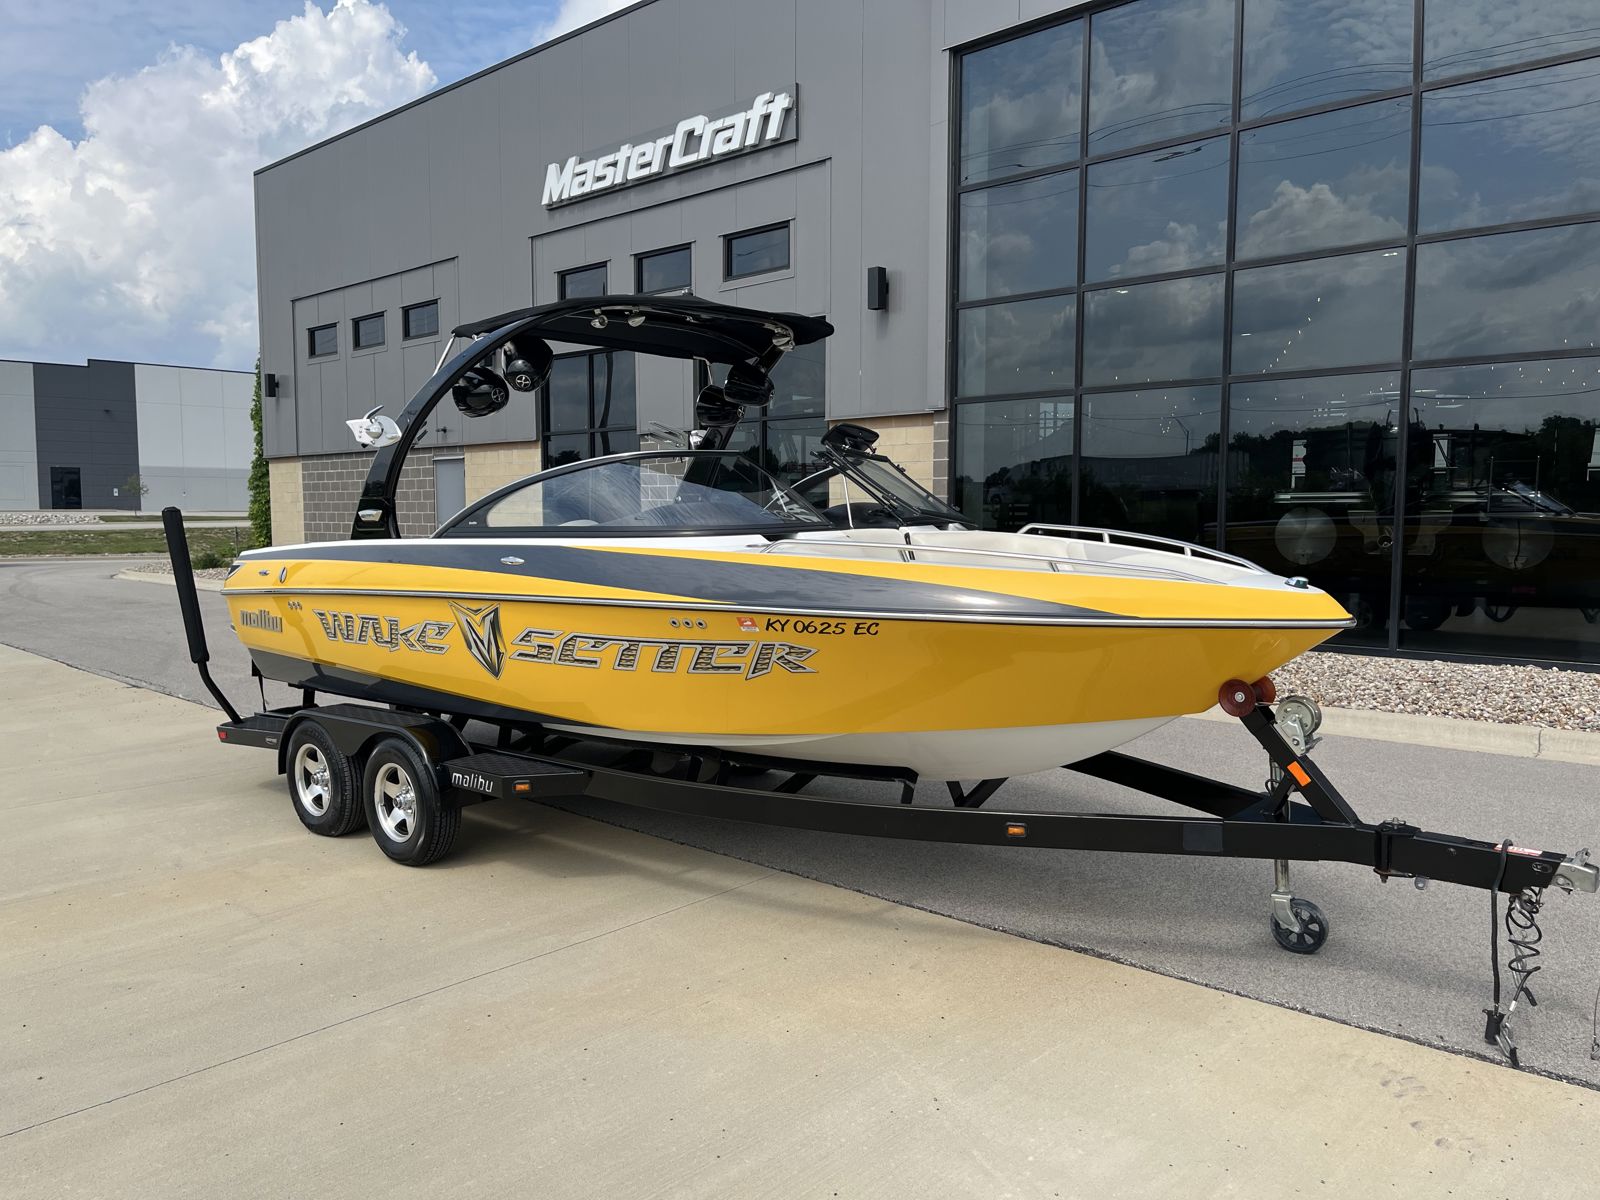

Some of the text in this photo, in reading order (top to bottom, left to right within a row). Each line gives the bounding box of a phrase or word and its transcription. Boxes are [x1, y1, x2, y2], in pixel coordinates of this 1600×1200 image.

[541, 91, 794, 205] MasterCraft
[765, 618, 790, 632] KY
[793, 620, 846, 635] 0625
[853, 622, 879, 635] EC
[451, 772, 494, 793] malibu
